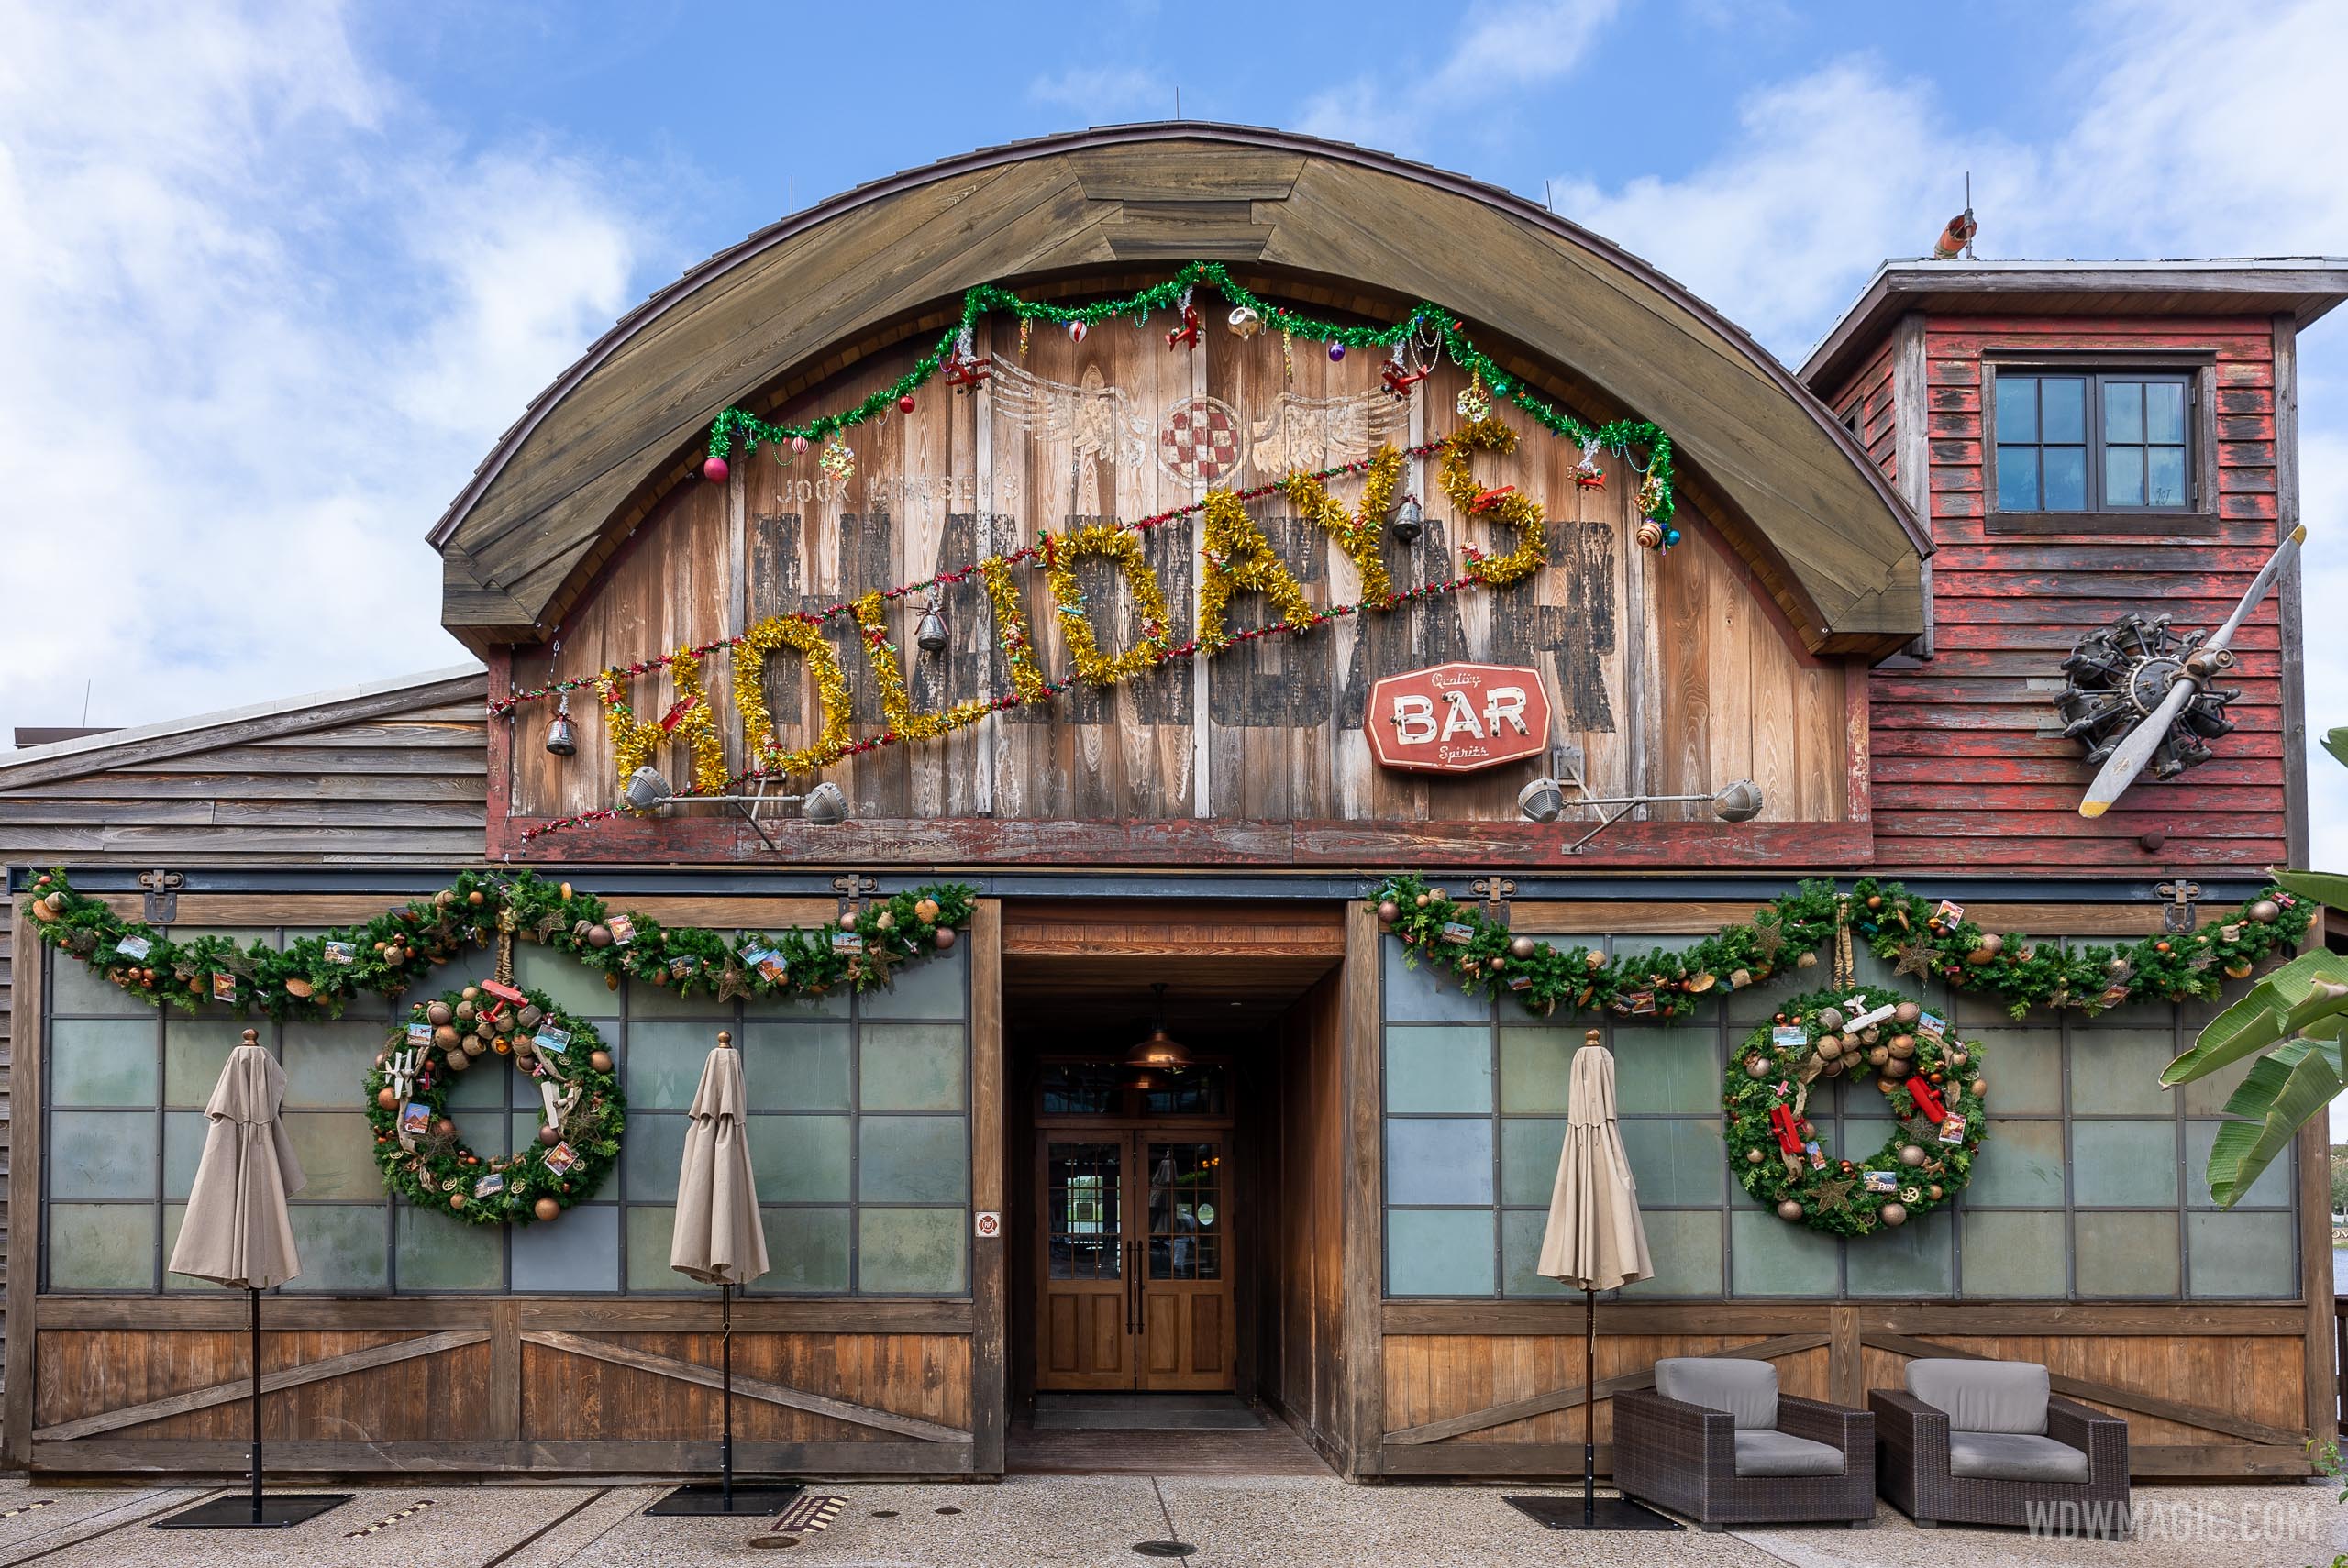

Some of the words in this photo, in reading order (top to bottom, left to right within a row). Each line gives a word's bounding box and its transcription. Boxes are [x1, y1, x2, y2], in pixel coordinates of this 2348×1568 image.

[596, 417, 1547, 816] HOLIDAYS
[1431, 672, 1482, 689] Quality
[1390, 687, 1531, 745] BAR
[1438, 745, 1490, 764] Spirits
